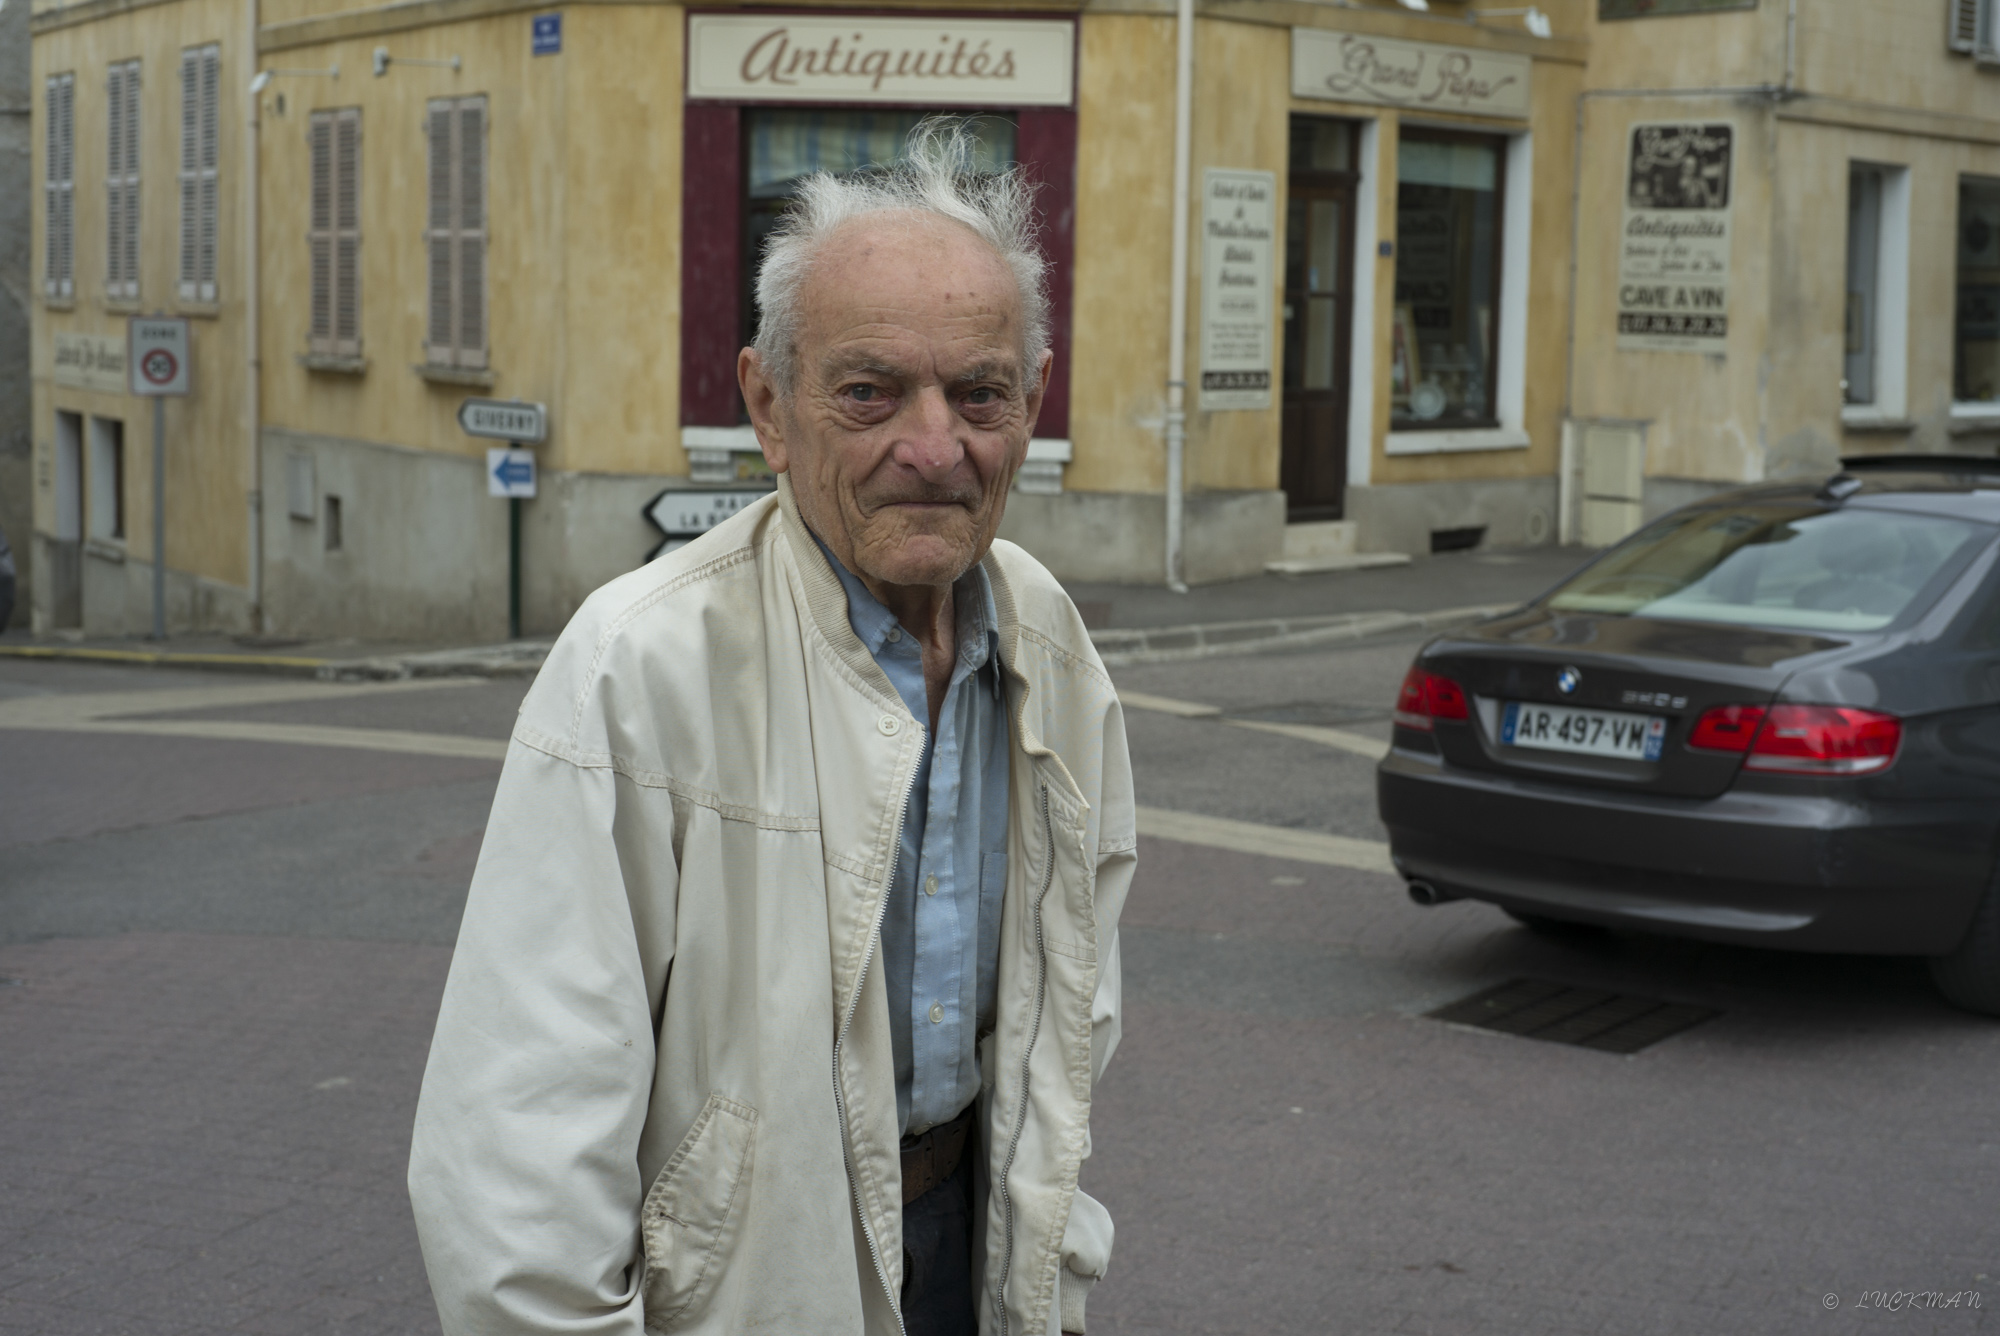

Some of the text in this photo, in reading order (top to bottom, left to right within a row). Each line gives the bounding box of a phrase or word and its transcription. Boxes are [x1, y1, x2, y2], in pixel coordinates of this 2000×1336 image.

[740, 27, 1017, 92] Antiquités
[1326, 35, 1518, 107] Grand Papa
[1625, 213, 1725, 242] Antiquités
[1620, 285, 1724, 308] CAVE A VIN
[141, 327, 178, 340] ZONE
[148, 358, 172, 375] 30
[473, 408, 536, 432] GIVERNY
[680, 512, 702, 527] LA
